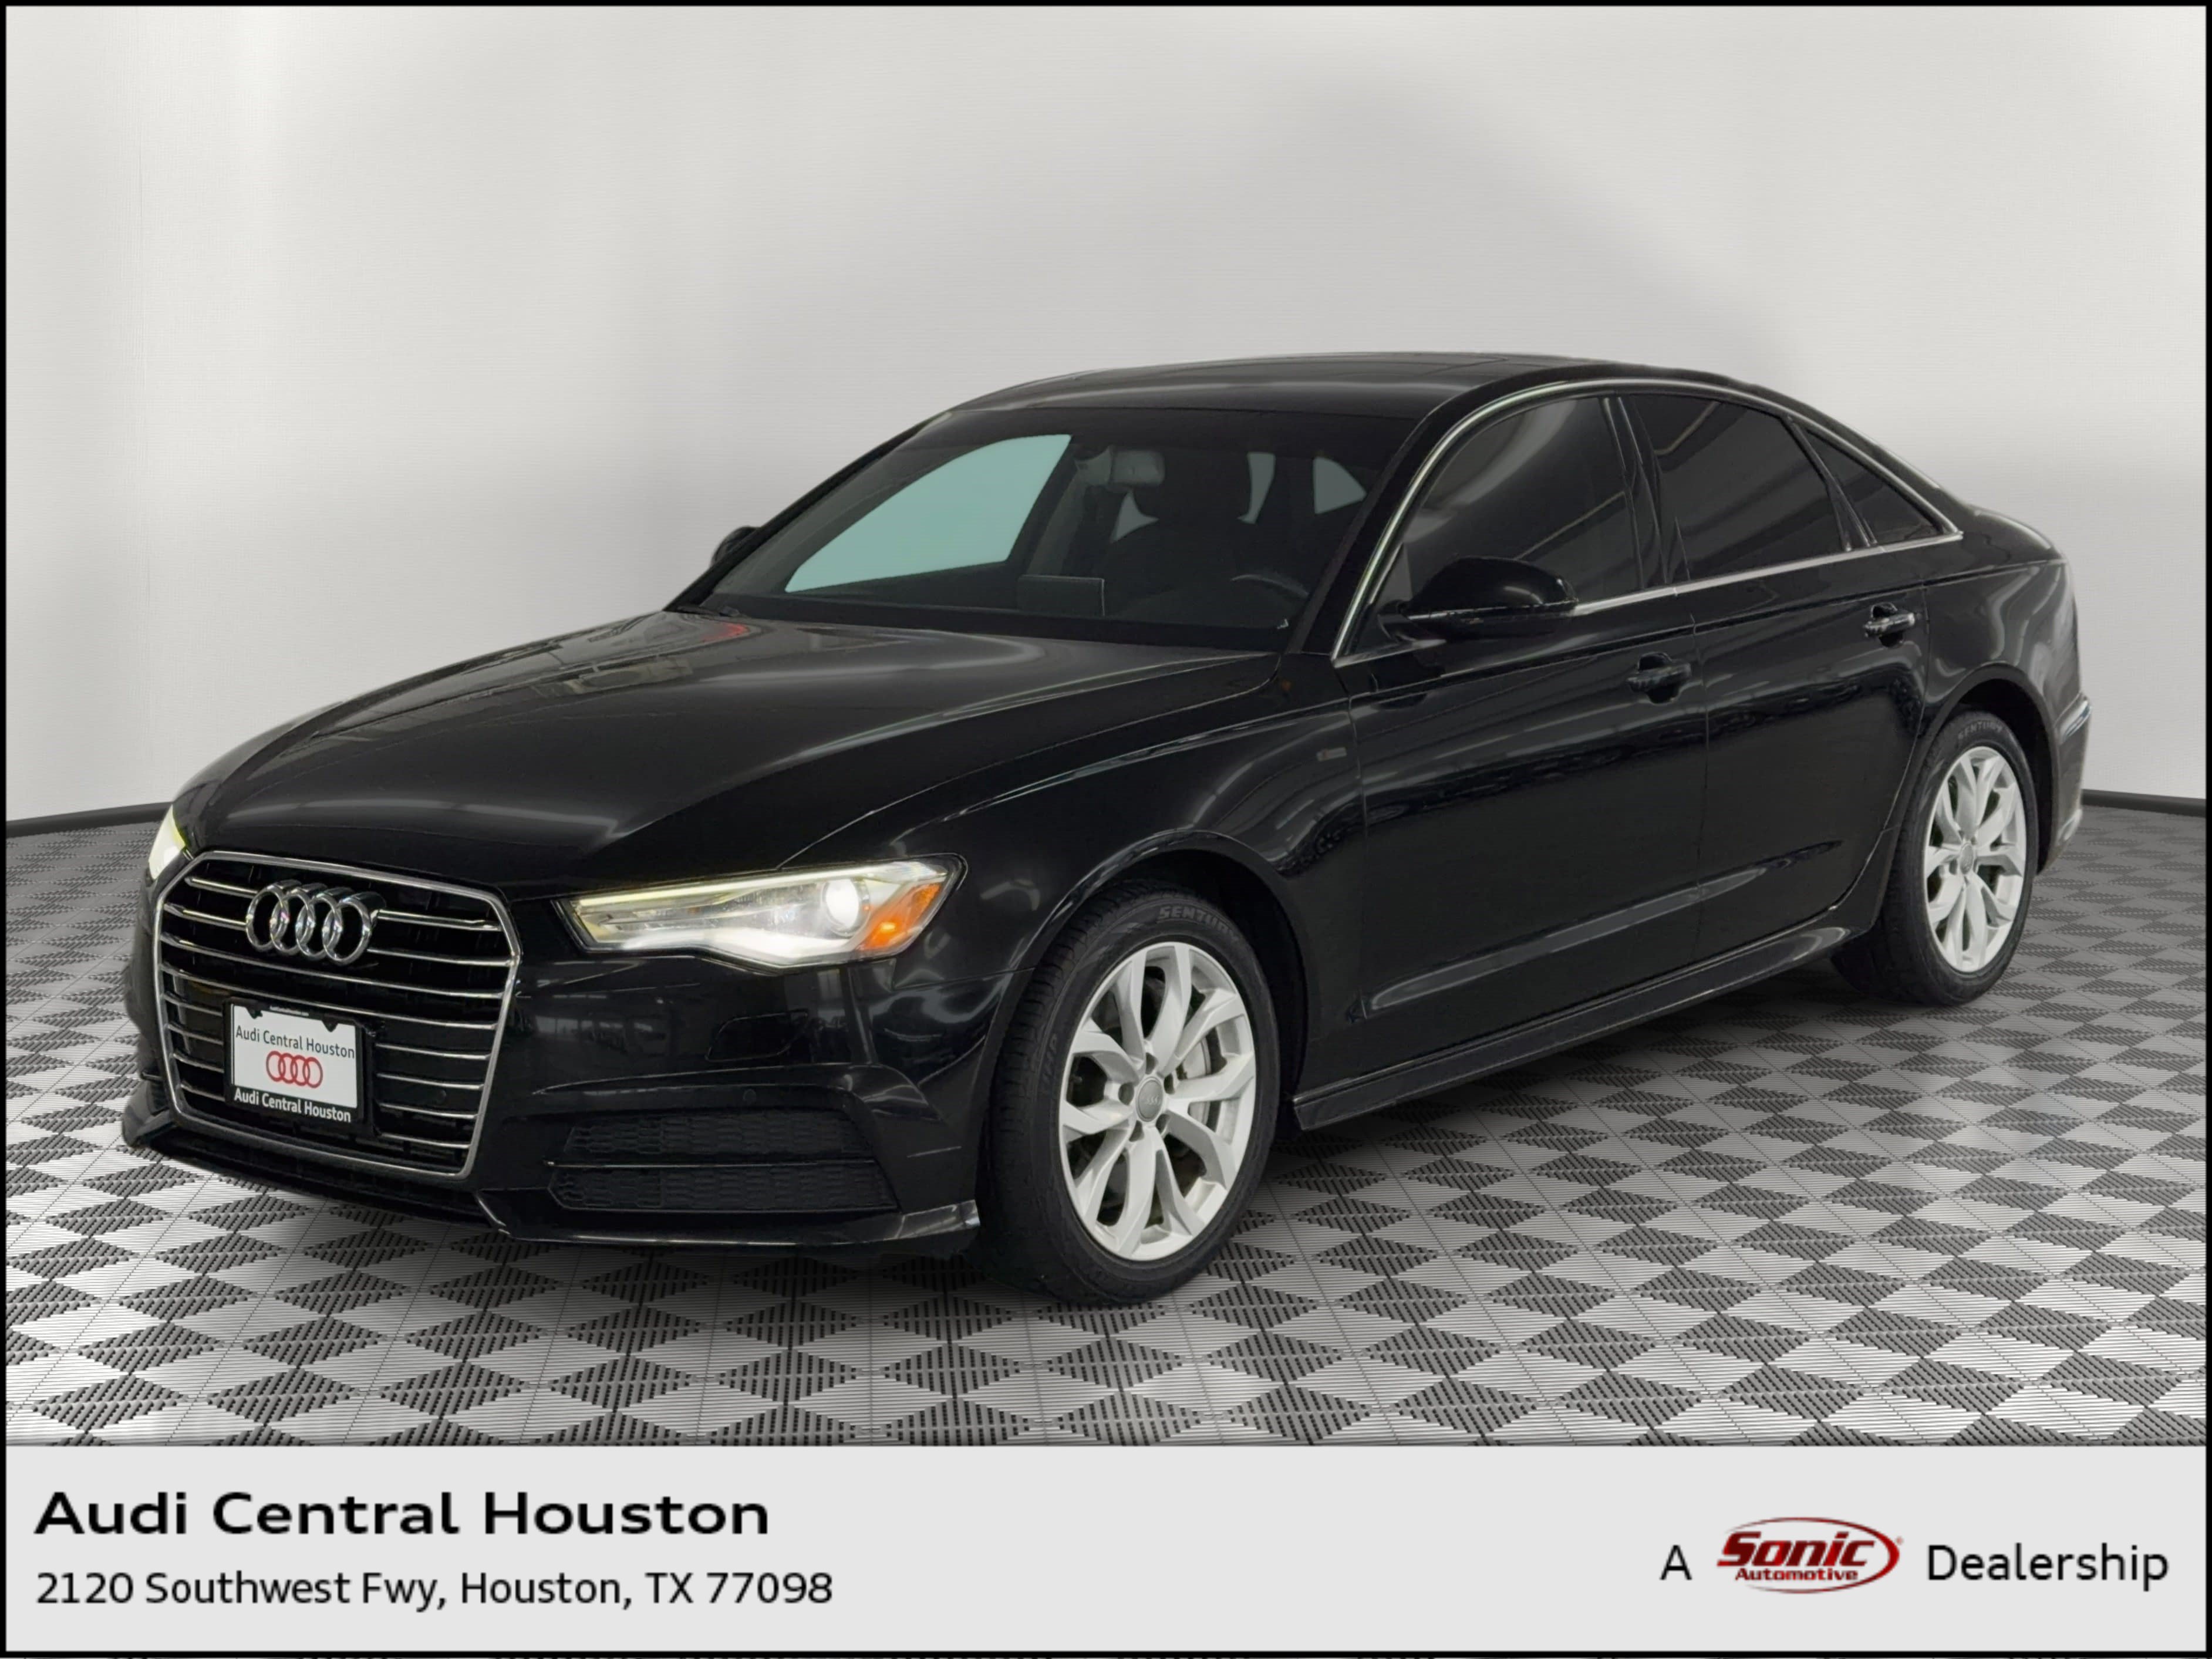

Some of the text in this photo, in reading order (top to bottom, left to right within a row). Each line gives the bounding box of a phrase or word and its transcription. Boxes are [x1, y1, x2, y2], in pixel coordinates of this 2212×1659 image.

[236, 1026, 355, 1058] Audi Central Houston
[234, 1088, 351, 1122] Audi Central Houston
